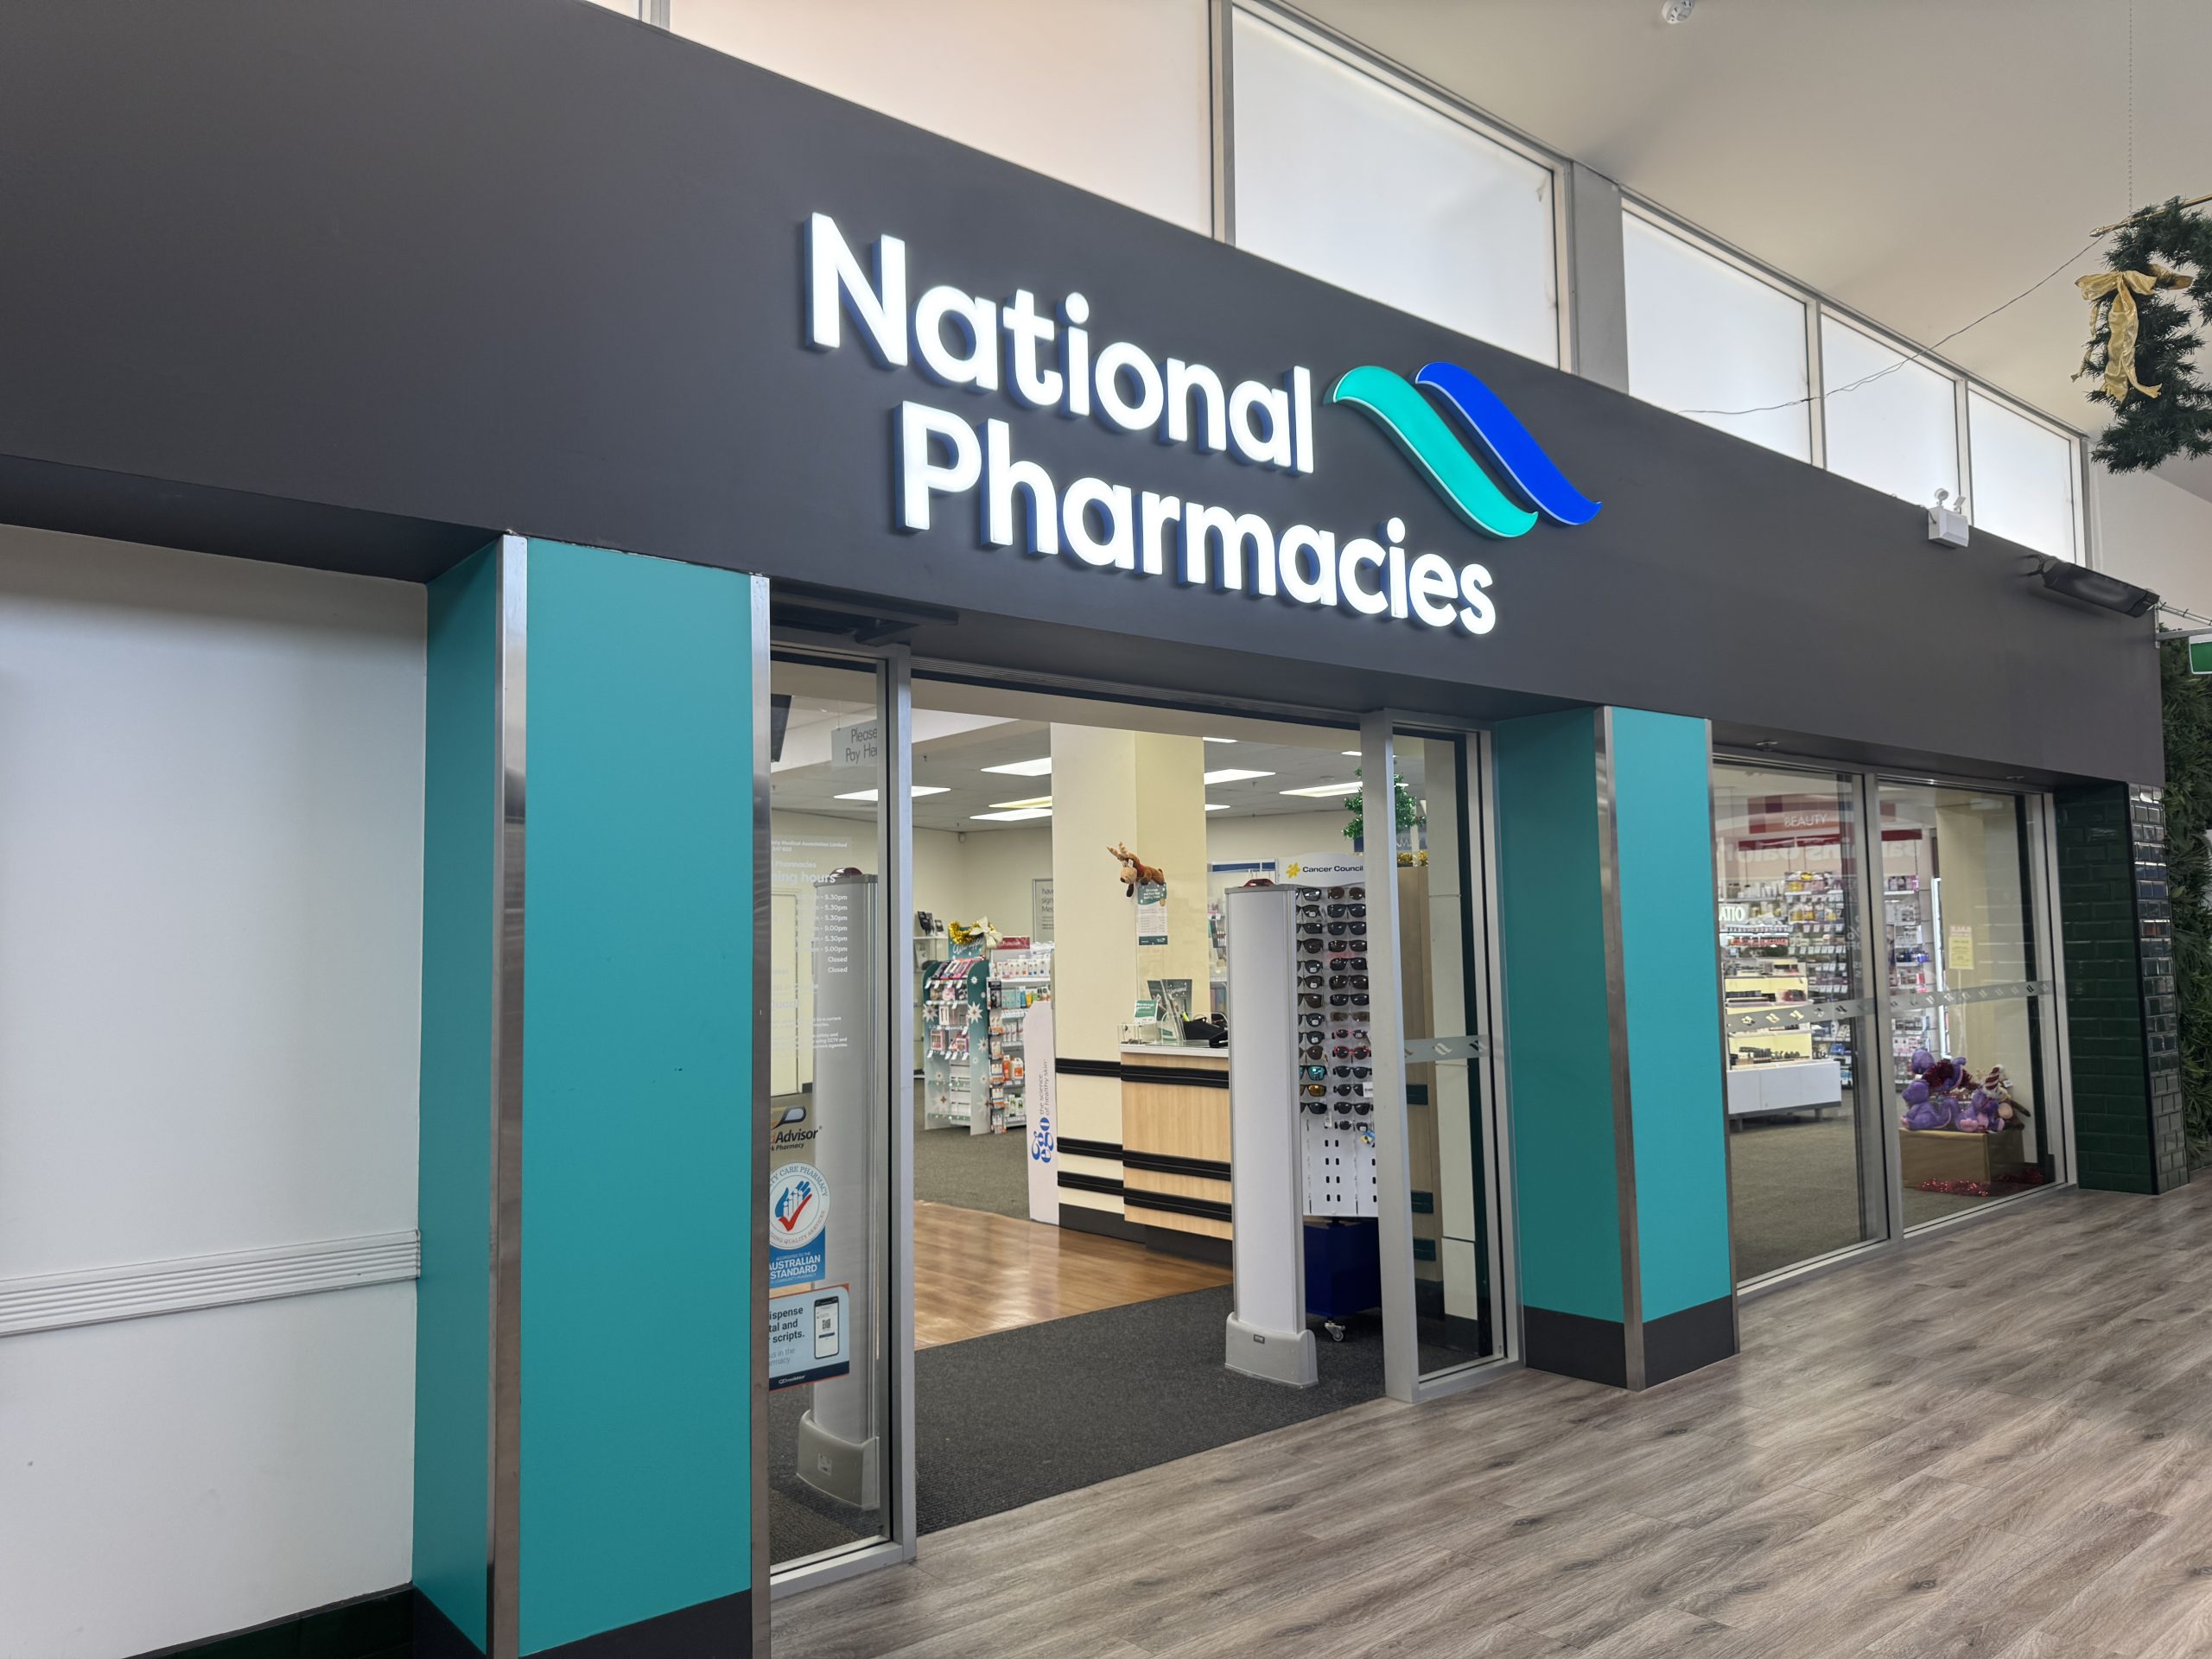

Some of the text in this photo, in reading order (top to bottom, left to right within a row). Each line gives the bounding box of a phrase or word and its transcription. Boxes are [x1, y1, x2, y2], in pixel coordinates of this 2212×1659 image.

[805, 212, 1313, 474] National
[895, 400, 1496, 635] Pharmacies
[850, 727, 877, 743] Please
[845, 747, 861, 764] Pay
[1784, 814, 1827, 828] BEAUTY
[801, 871, 836, 883] hours
[775, 1142, 804, 1151] Pharmacy
[1032, 1116, 1054, 1164] ego
[779, 1166, 799, 1176] CARE
[800, 1166, 828, 1197] PHARMACY
[784, 1234, 808, 1245] QUALITY
[808, 1211, 825, 1236] SERVICES
[770, 1264, 817, 1280] STANDARD
[782, 1319, 798, 1331] and
[772, 1332, 805, 1344] scripts.
